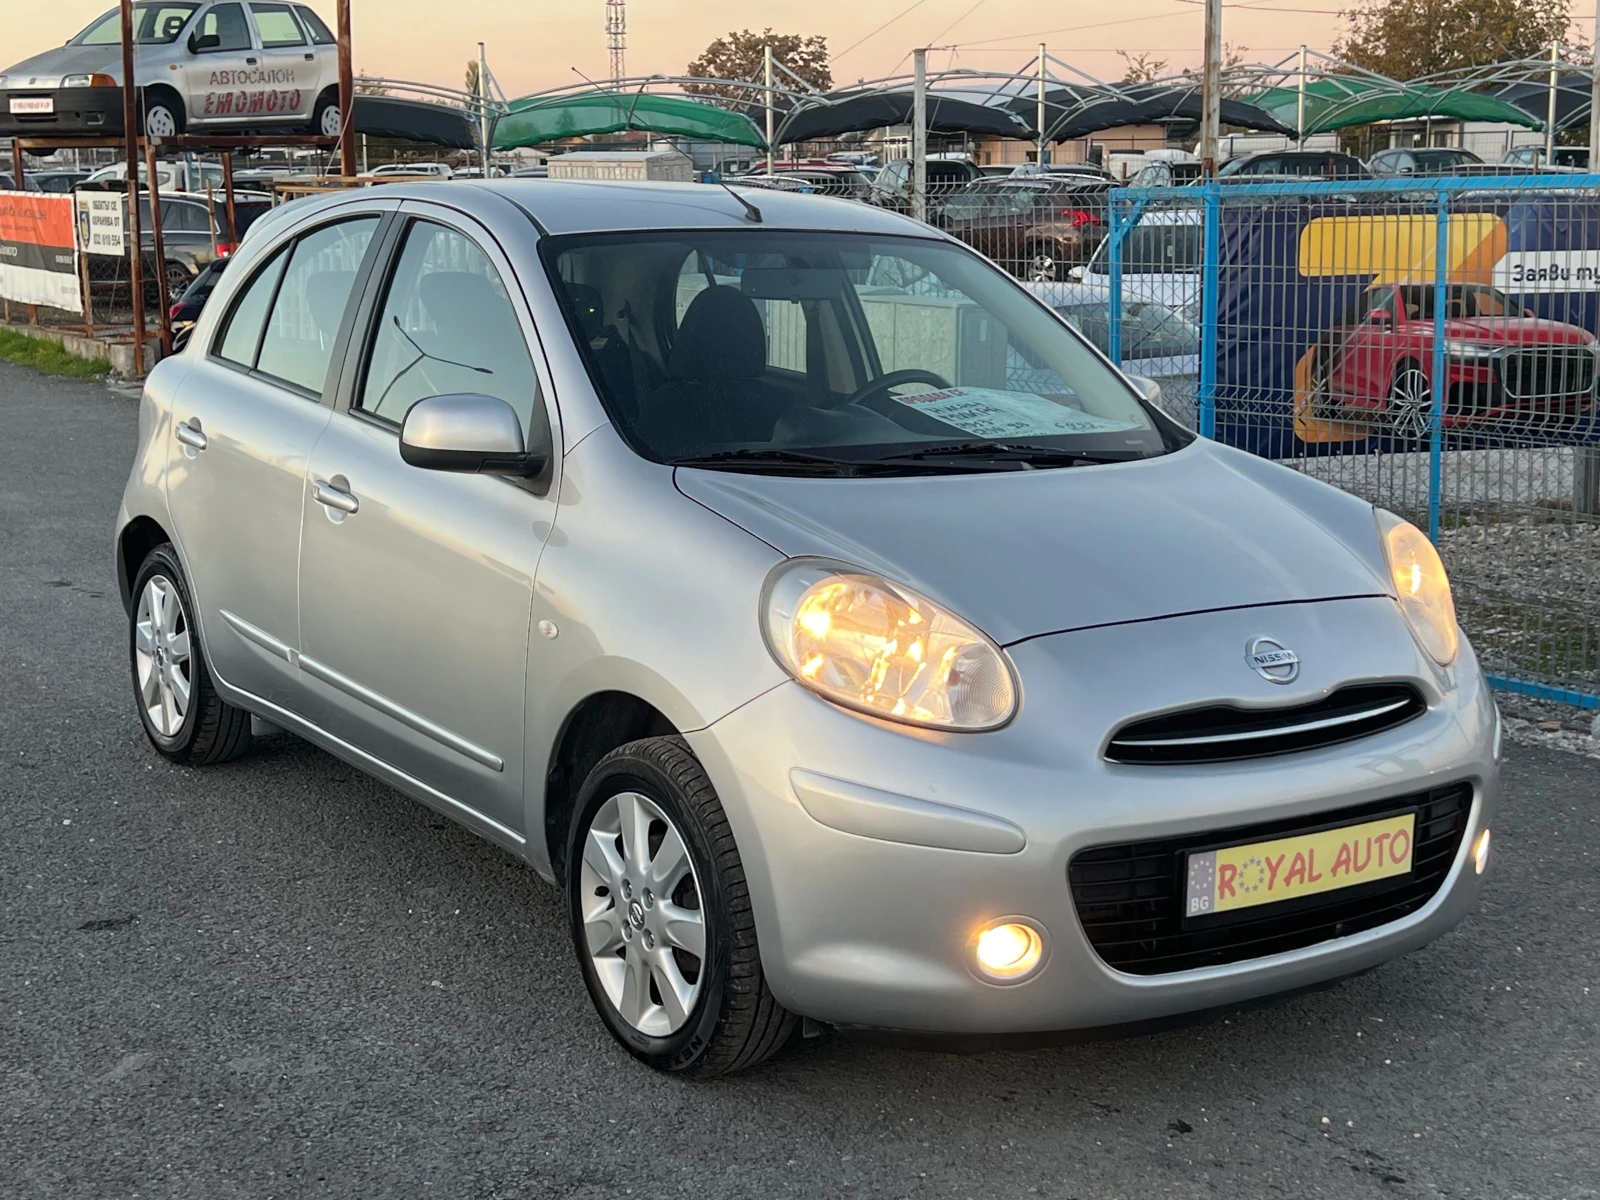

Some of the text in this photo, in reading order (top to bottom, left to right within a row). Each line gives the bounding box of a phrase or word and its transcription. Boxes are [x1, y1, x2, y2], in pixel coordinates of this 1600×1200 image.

[209, 69, 295, 85] АВТОСАЛОН
[1513, 264, 1570, 282] Заяви
[1253, 652, 1296, 664] NISSAN
[1330, 829, 1410, 878] AUTO
[1190, 896, 1209, 912] BG
